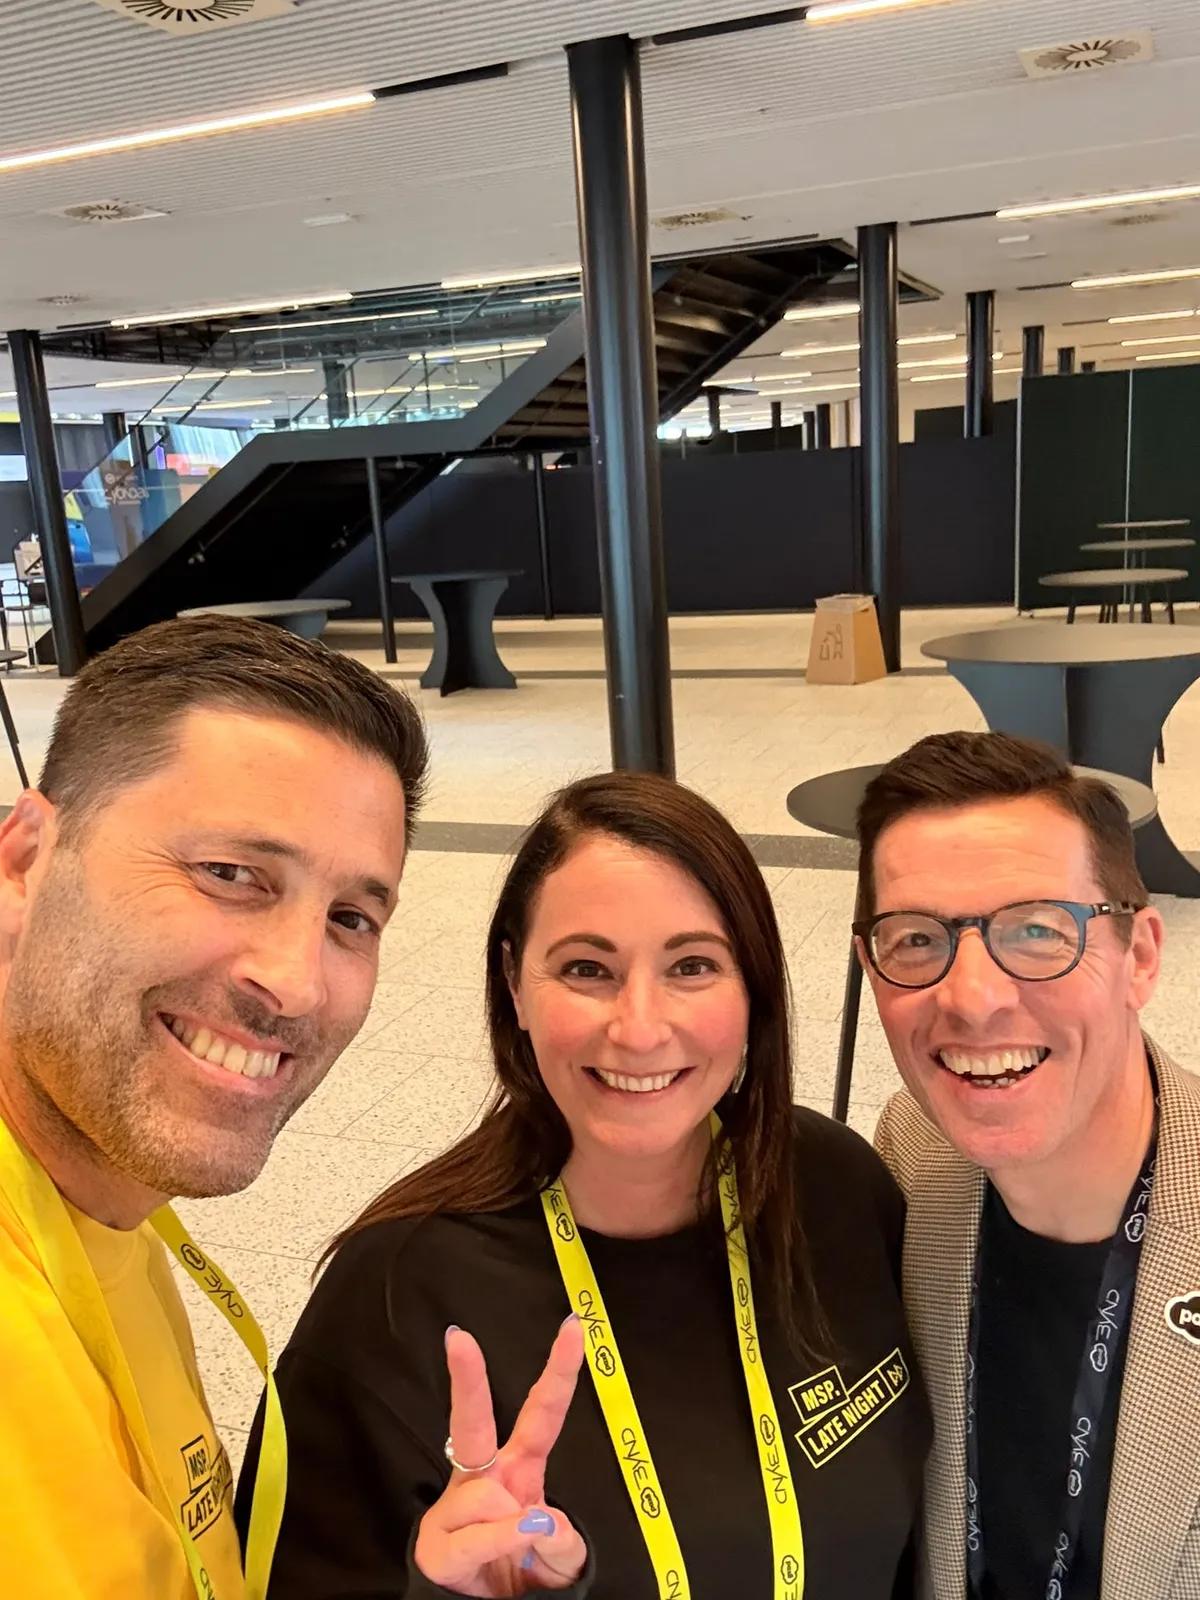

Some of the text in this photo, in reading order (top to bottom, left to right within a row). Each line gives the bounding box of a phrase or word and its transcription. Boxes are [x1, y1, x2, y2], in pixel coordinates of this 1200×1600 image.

[801, 1379, 841, 1412] MSP.
[807, 1379, 885, 1456] LATE NIGHT
[187, 1491, 214, 1534] LATE
